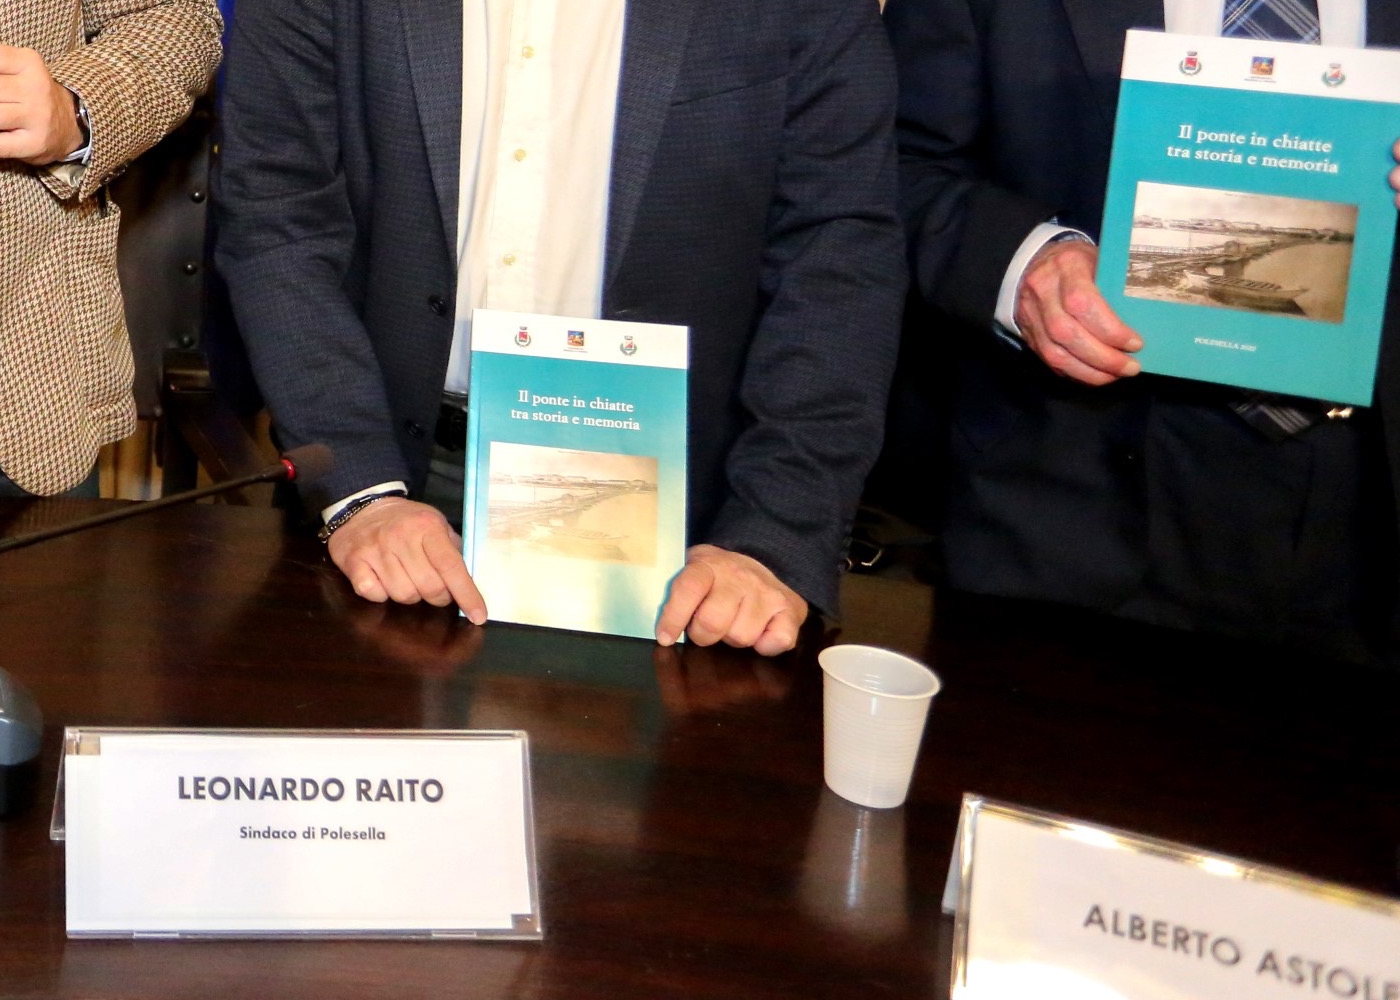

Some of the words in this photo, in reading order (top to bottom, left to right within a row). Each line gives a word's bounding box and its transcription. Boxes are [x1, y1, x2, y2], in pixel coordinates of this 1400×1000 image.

[1178, 124, 1193, 139] Il
[1196, 130, 1246, 145] ponte
[1249, 132, 1268, 147] in
[1272, 133, 1333, 153] chiatte
[1166, 144, 1191, 159] tra
[1194, 148, 1243, 164] storia
[1246, 155, 1258, 165] e
[1261, 155, 1339, 174] memoria
[518, 389, 529, 403] Il
[531, 395, 570, 408] ponte
[572, 395, 586, 408] in
[589, 396, 634, 413] chiatte
[511, 408, 529, 420] tra
[532, 410, 570, 425] storia
[572, 416, 580, 425] e
[583, 416, 641, 431] memoria
[178, 776, 345, 802] LEONARDO
[356, 778, 445, 803] RAITO
[239, 825, 297, 840] Sindaco
[302, 826, 316, 840] di
[320, 826, 386, 841] Polesella
[1082, 903, 1242, 967] ALBERTO
